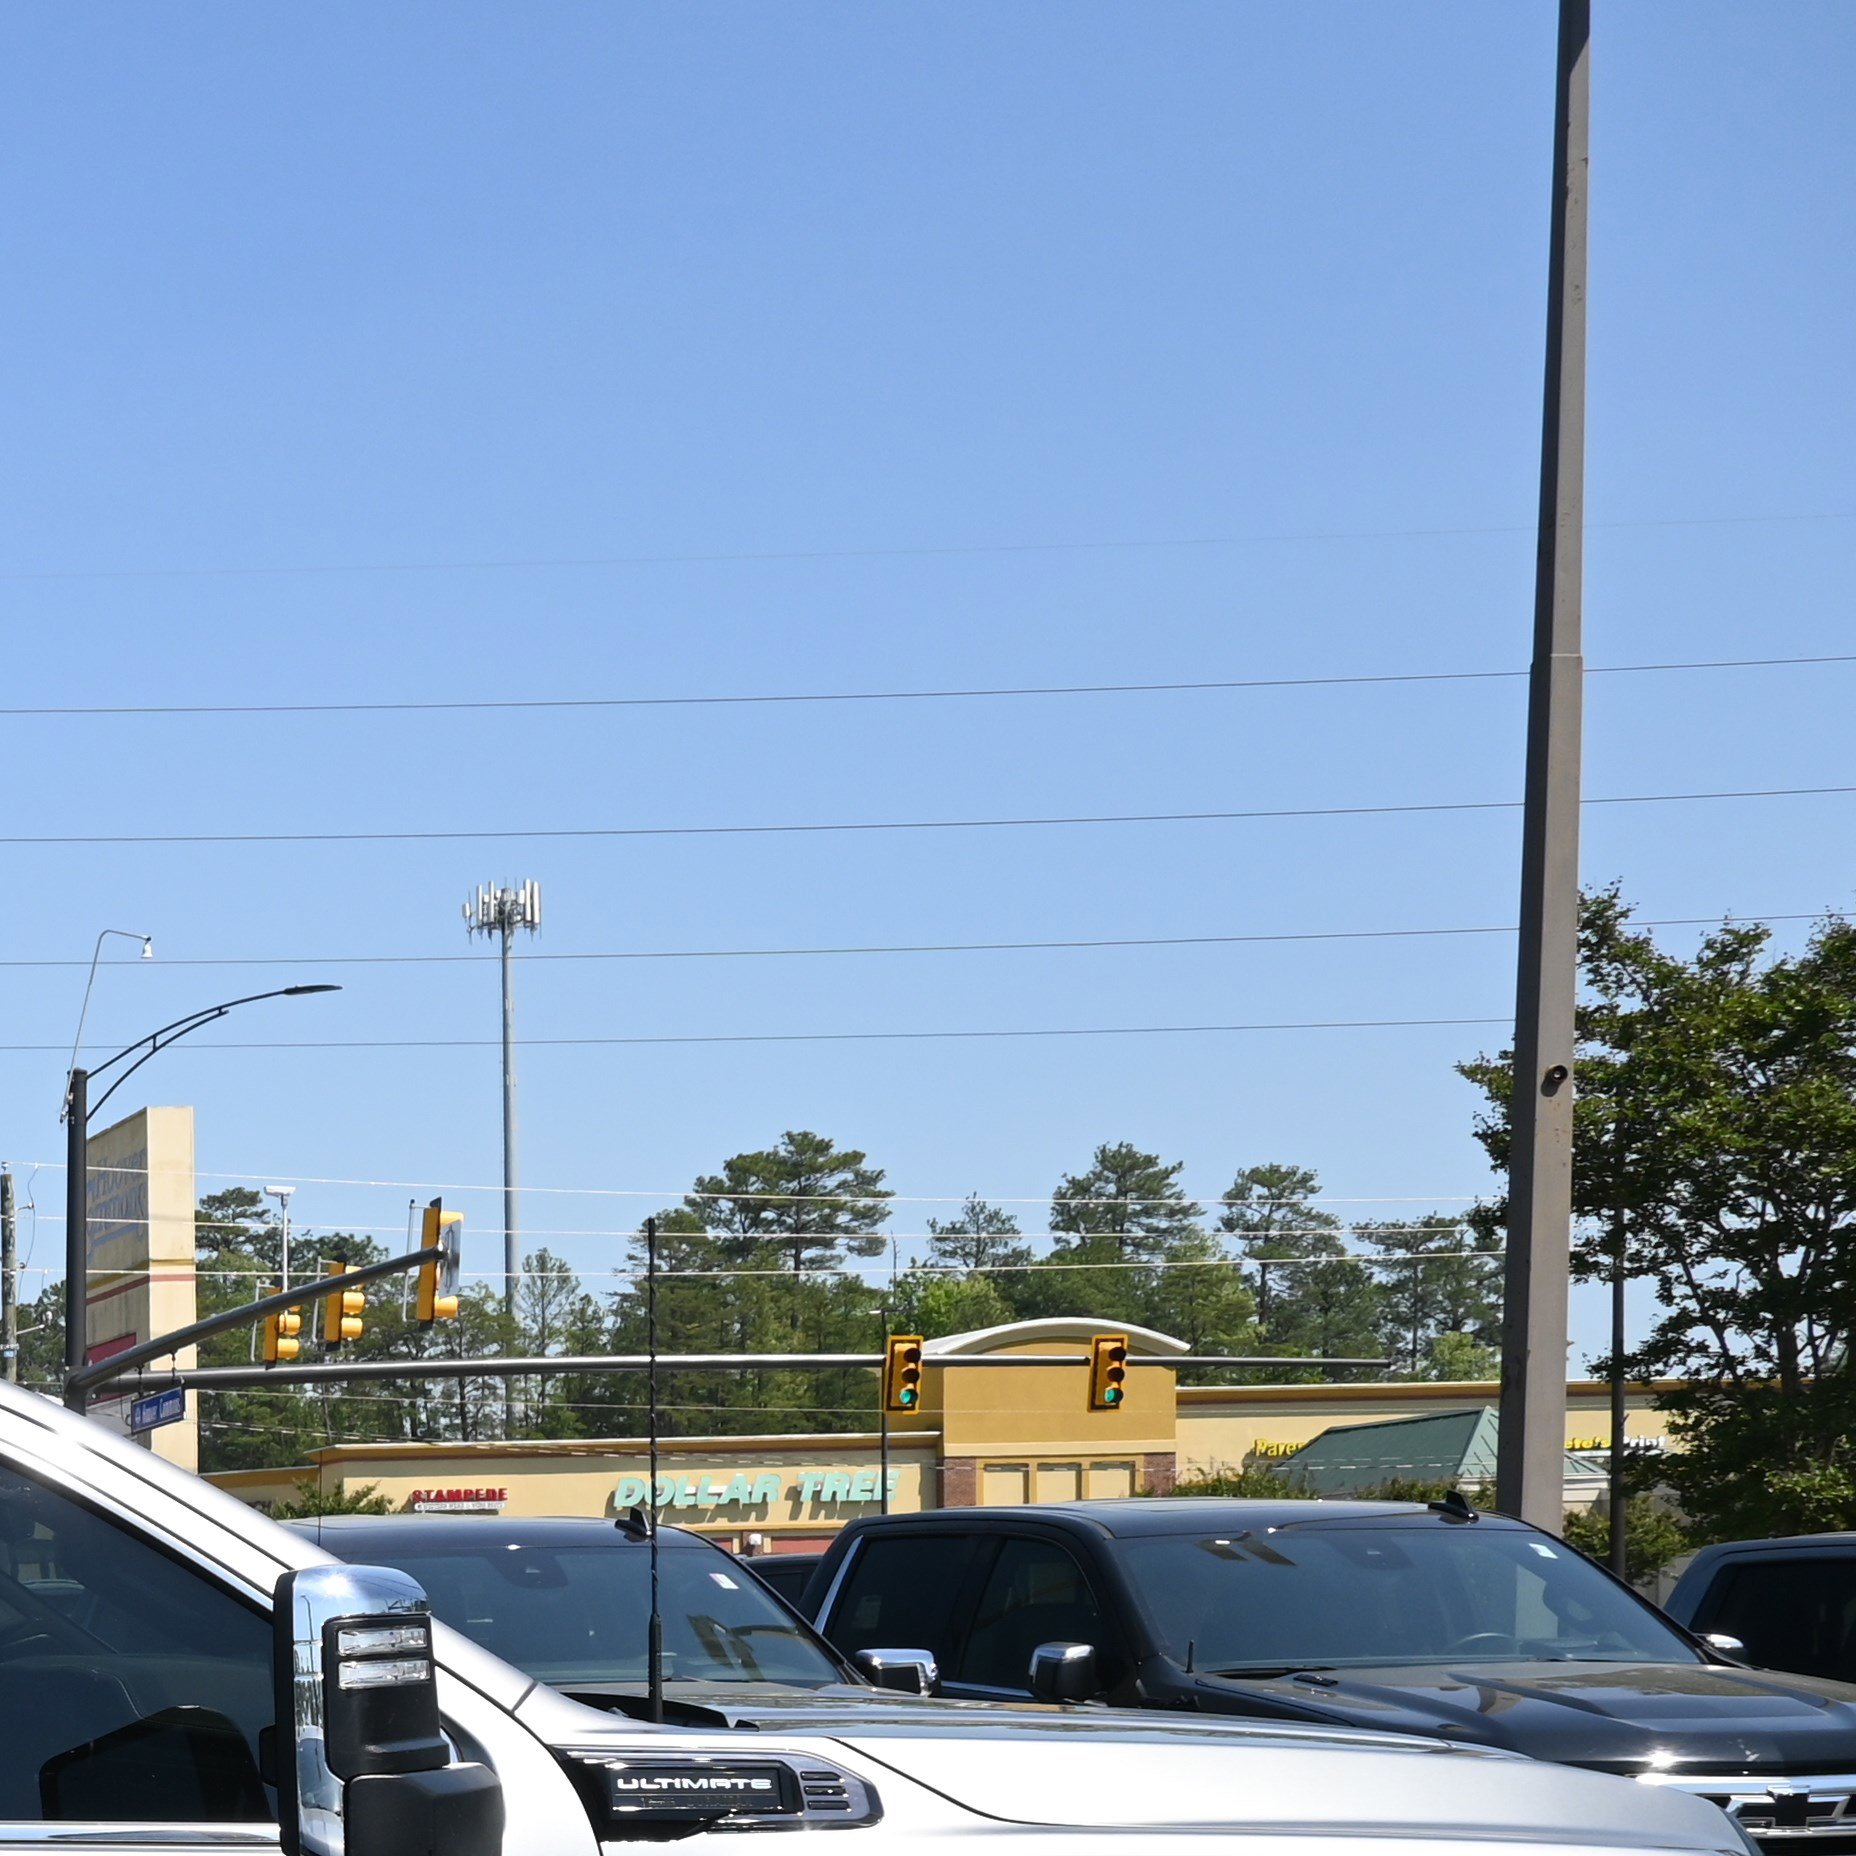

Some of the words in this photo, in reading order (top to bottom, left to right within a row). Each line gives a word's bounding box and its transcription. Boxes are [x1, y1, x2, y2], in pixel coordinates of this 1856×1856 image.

[412, 1488, 508, 1502] STAMPEDE
[613, 1473, 782, 1507] DOLLAR
[799, 1470, 900, 1502] TREE
[616, 1778, 773, 1790] ULTIMATE
